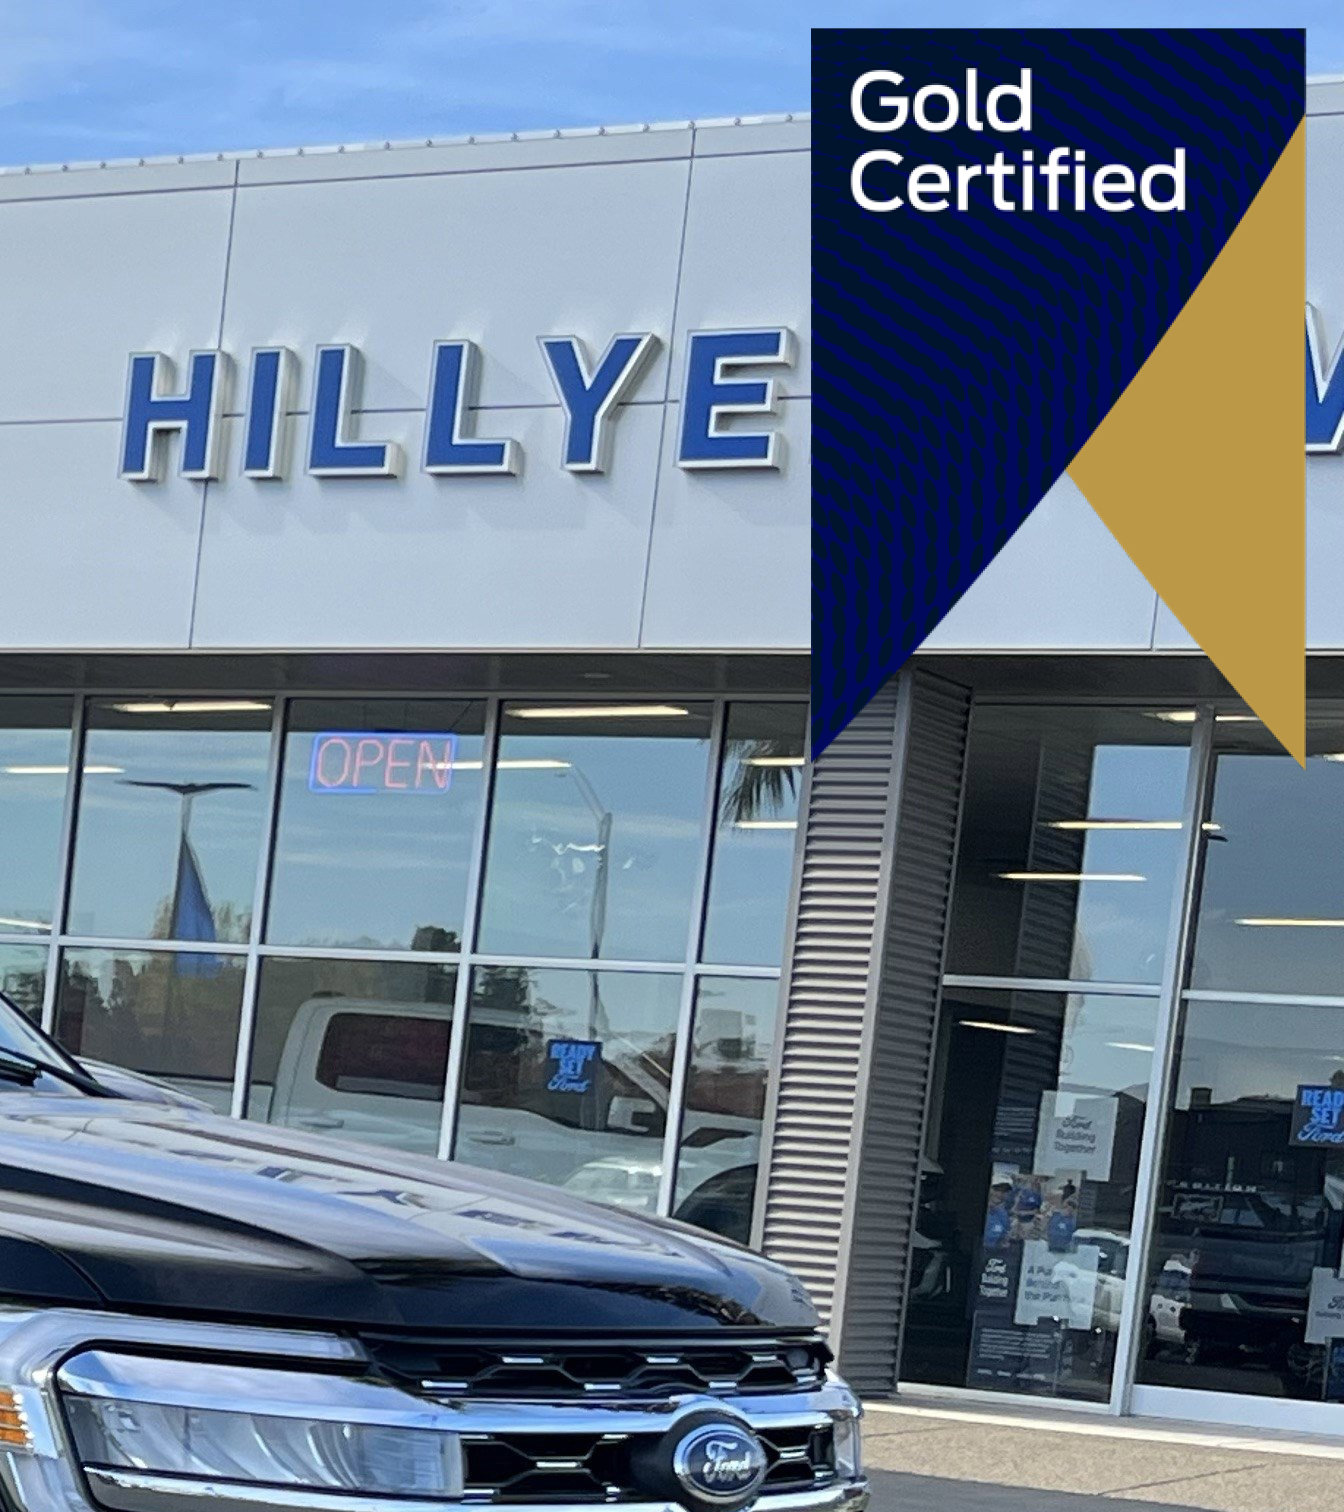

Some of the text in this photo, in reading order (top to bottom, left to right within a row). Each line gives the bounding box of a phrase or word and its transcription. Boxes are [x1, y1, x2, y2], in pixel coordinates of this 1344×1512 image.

[120, 326, 794, 482] HILLYE
[316, 737, 451, 789] OPEN
[547, 1074, 590, 1093] Ford
[1301, 1089, 1344, 1107] READ
[1311, 1107, 1339, 1125] SET
[702, 1440, 753, 1484] Ford
